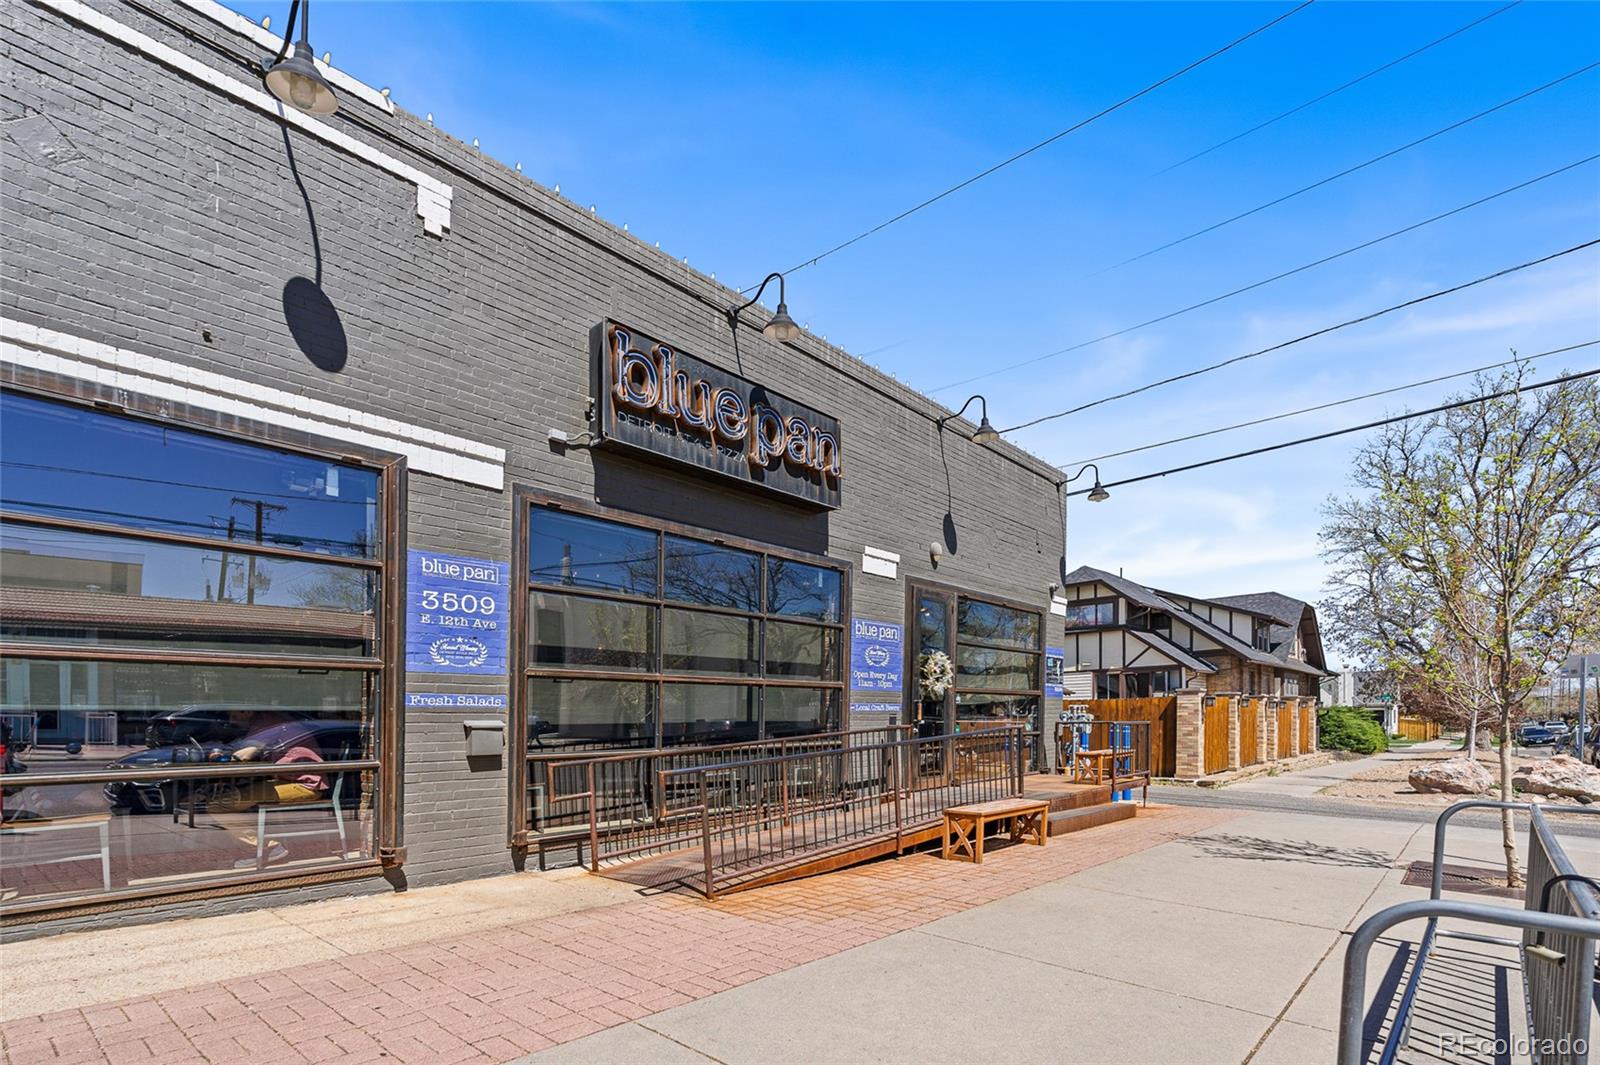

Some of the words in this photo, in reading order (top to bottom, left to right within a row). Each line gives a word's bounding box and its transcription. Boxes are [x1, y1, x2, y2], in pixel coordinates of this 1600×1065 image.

[610, 325, 748, 440] blue
[751, 403, 841, 476] pan
[617, 411, 673, 438] DETROIT
[421, 557, 460, 576] blue
[463, 566, 496, 581] pan
[422, 591, 496, 616] 3509
[421, 614, 435, 625] E.
[439, 615, 469, 627] 12th
[473, 619, 497, 630] Ave
[855, 621, 878, 636] blue
[879, 626, 898, 640] pan
[853, 670, 869, 680] Open
[869, 671, 887, 681] Every
[887, 672, 898, 681] Day
[858, 679, 874, 687] 11am
[877, 680, 893, 688] 10pm
[409, 695, 453, 706] Fresh
[457, 696, 502, 707] Salads
